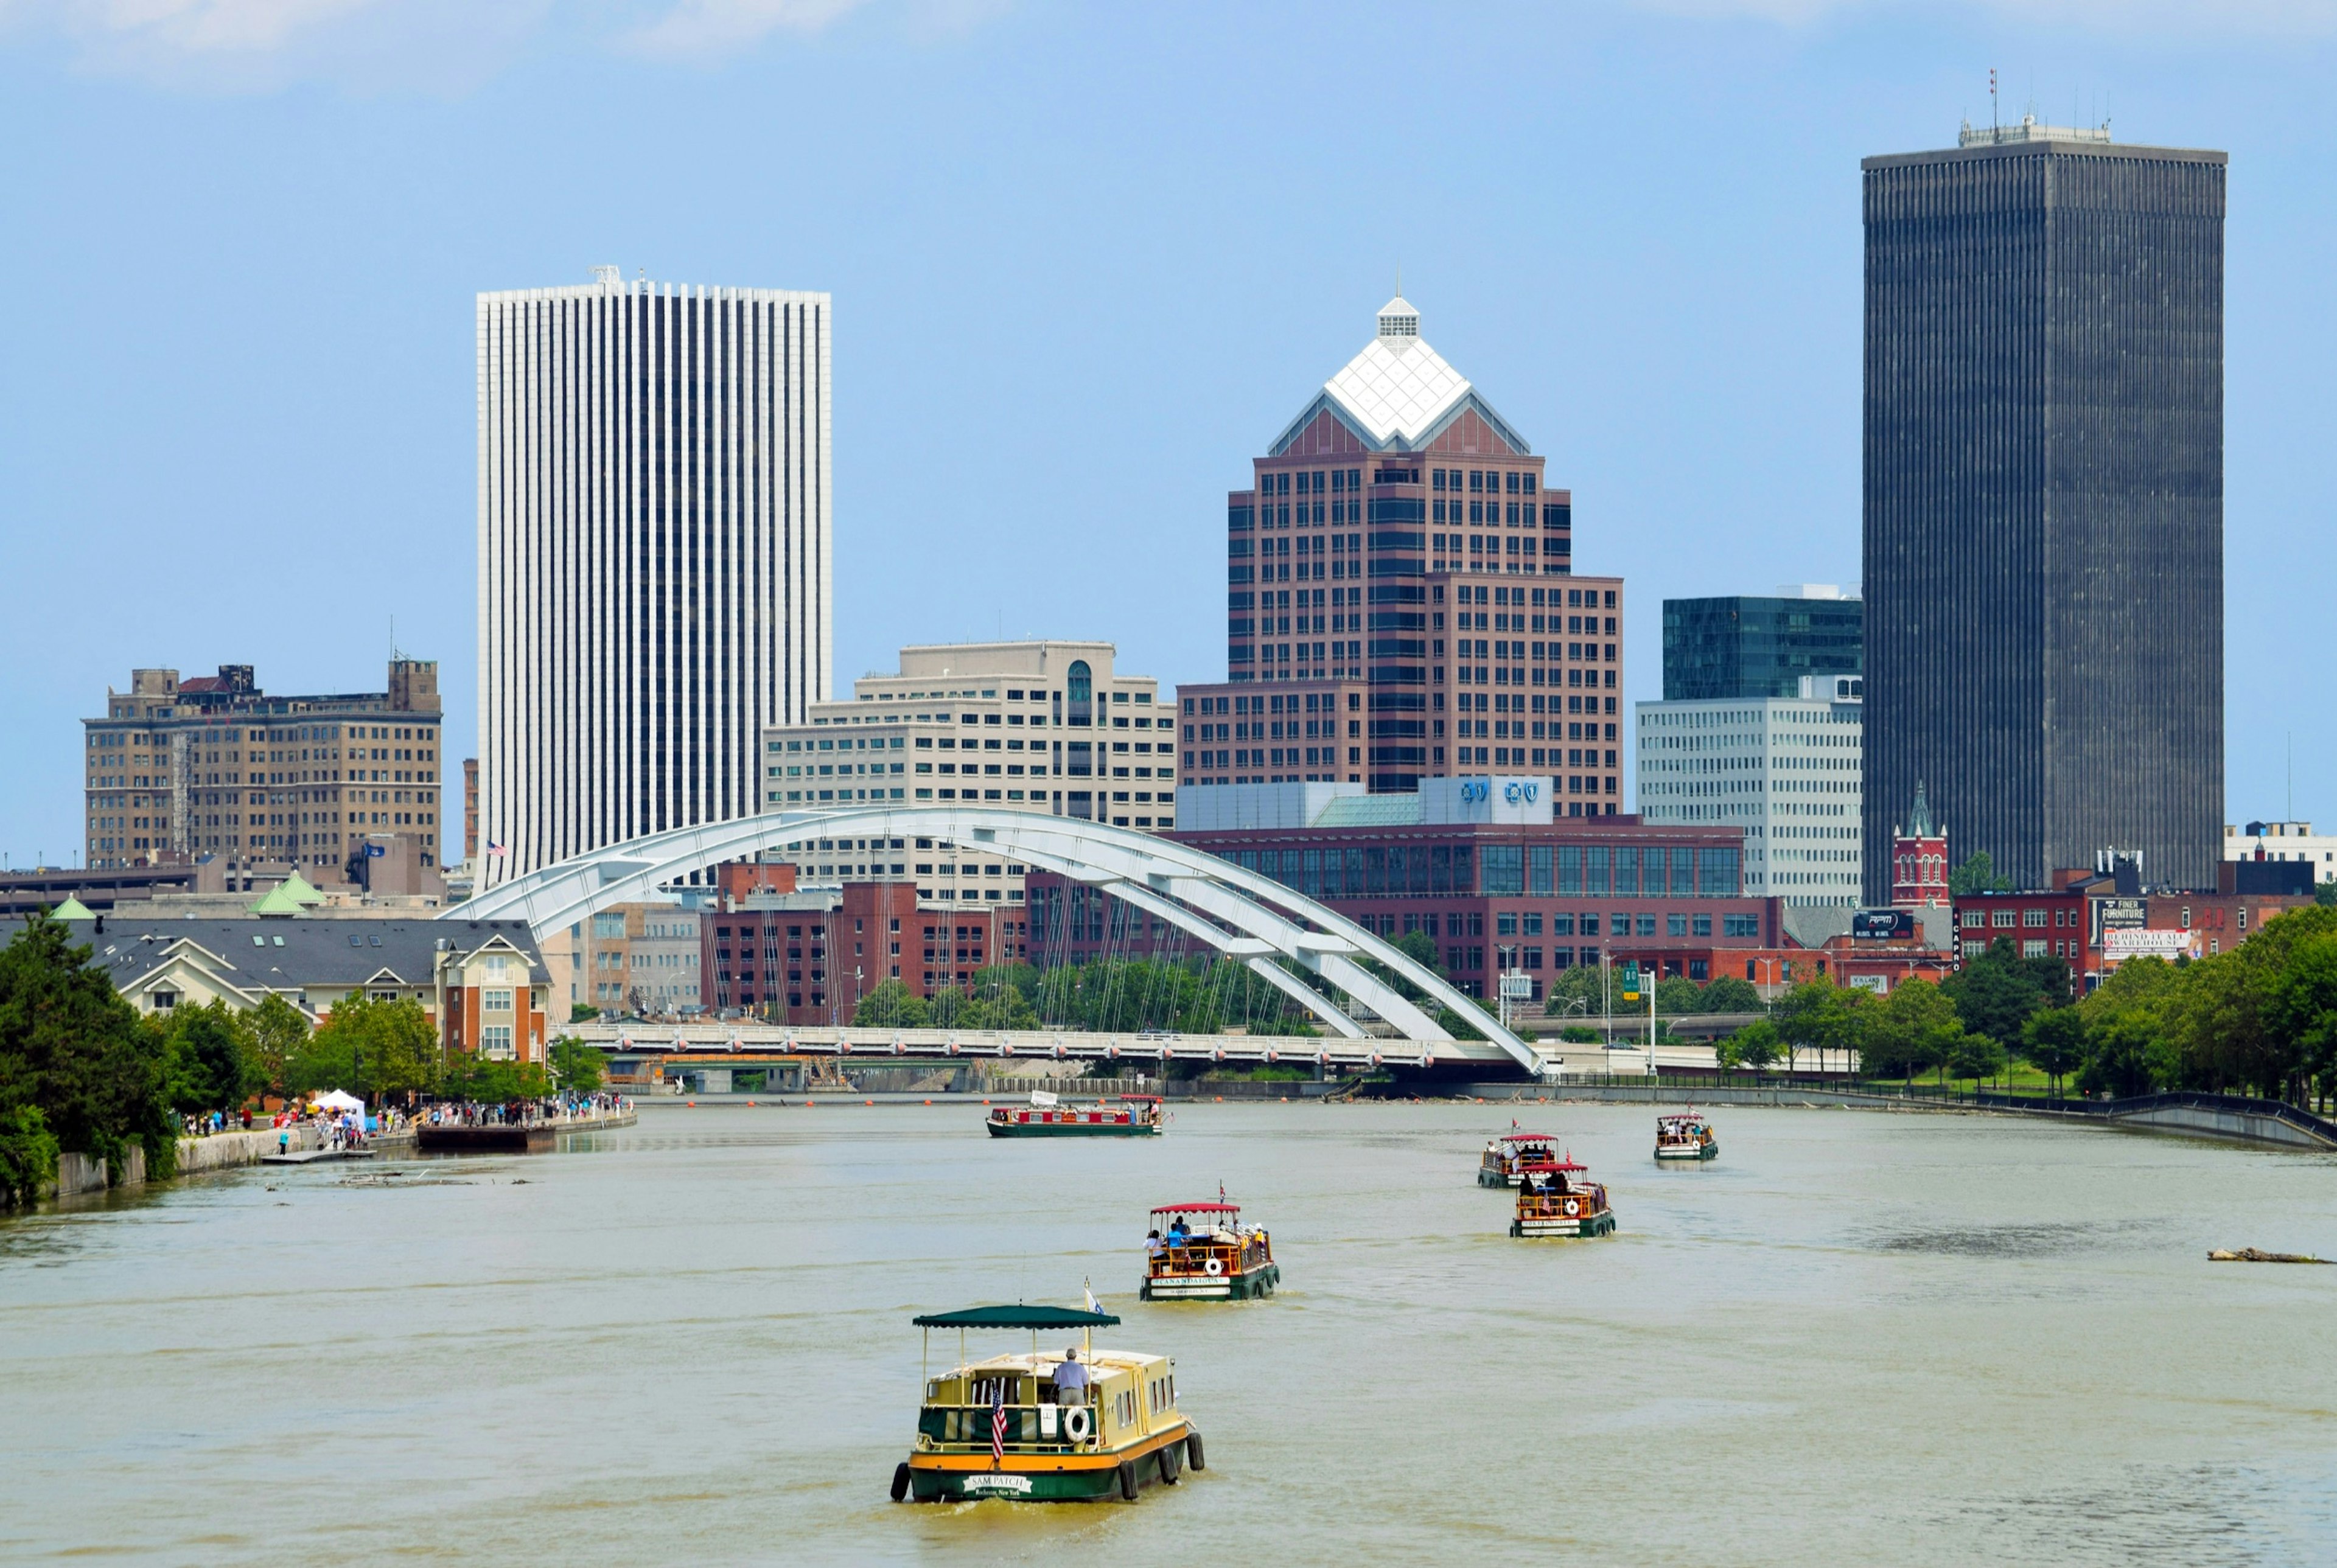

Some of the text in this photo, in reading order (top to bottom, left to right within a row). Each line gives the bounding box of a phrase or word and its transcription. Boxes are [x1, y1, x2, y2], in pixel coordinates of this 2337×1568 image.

[2102, 908, 2145, 919] FURNITURE
[1869, 915, 1892, 924] RPM
[973, 1476, 1023, 1486] SAM PATCH
